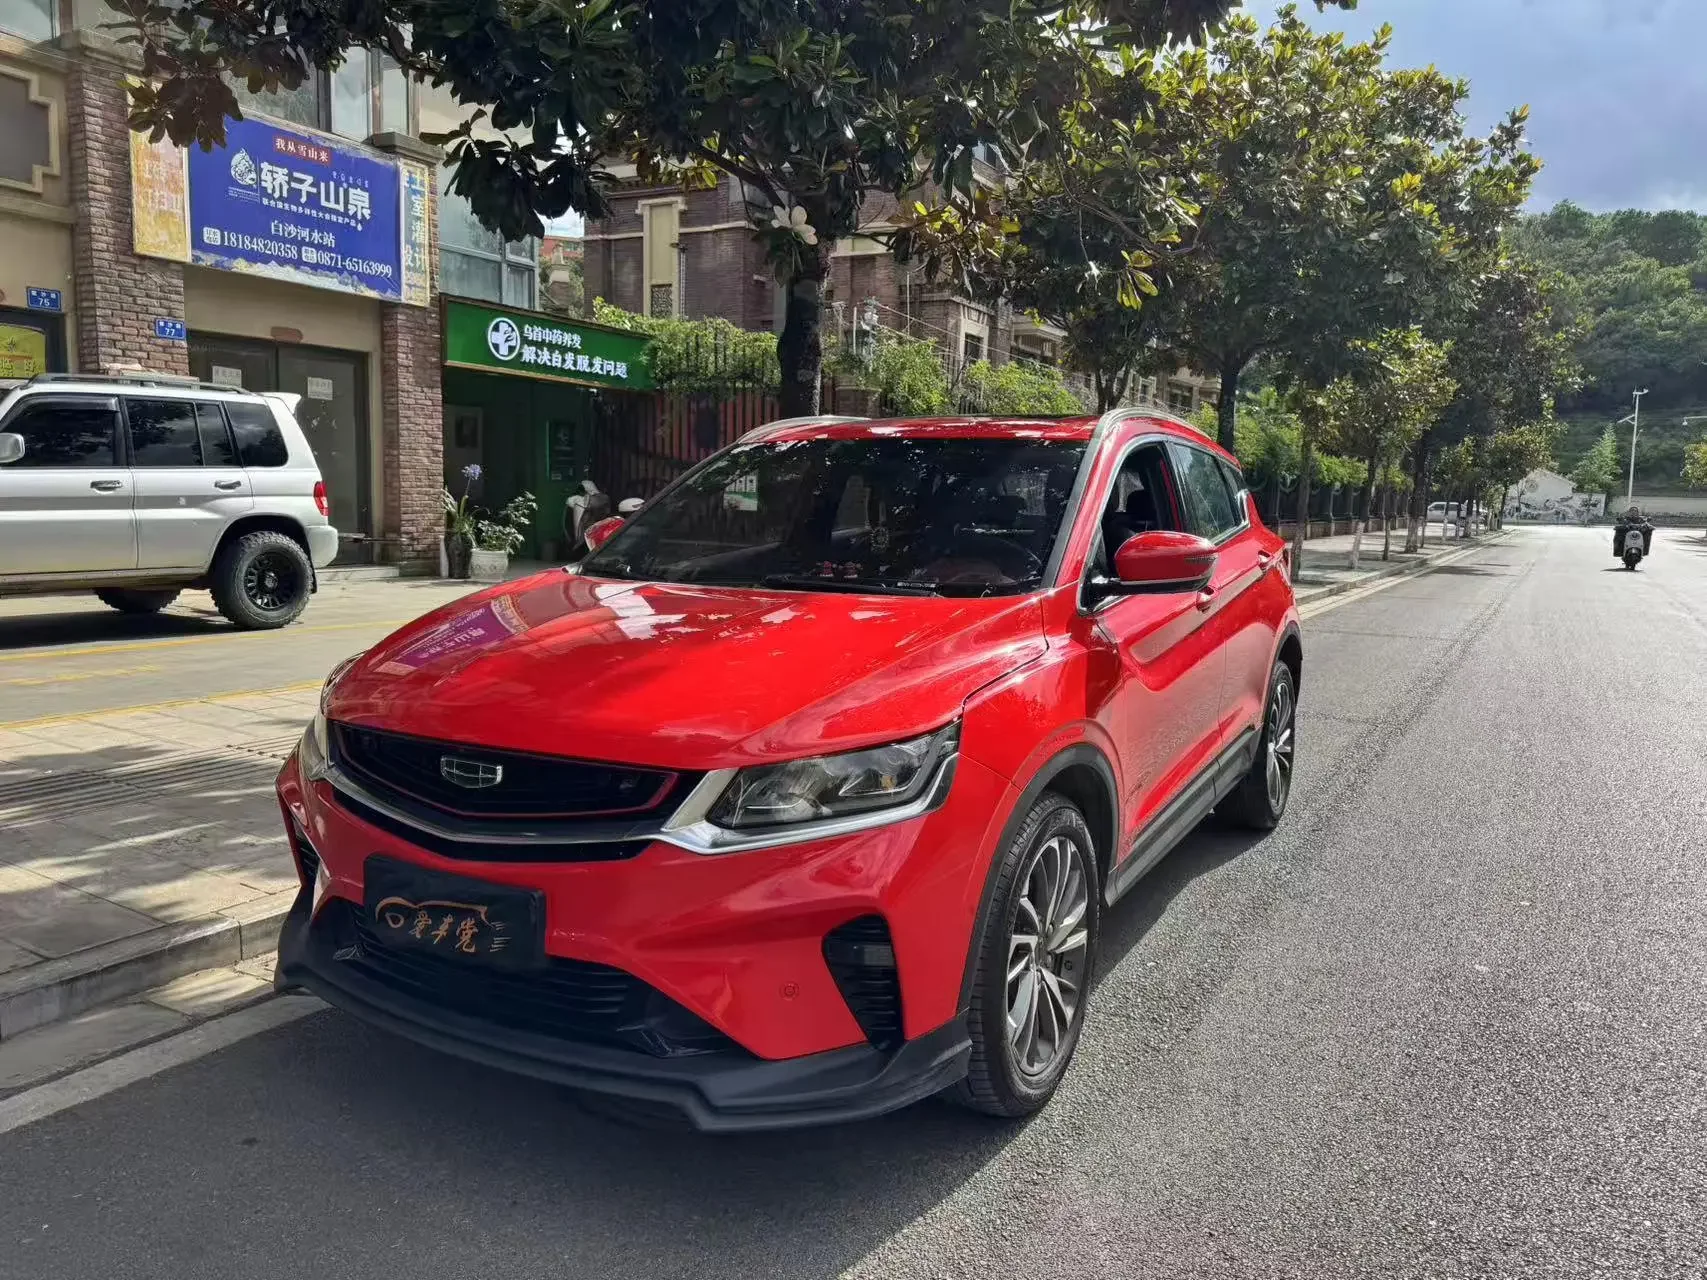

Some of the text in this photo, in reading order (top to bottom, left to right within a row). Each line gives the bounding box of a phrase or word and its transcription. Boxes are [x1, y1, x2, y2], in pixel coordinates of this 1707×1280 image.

[275, 138, 329, 162] 我从雪山来
[260, 161, 371, 221] 轿子山泉
[223, 231, 298, 259] 18184820358
[270, 219, 336, 248] 白沙河水站
[317, 250, 393, 278] 0871-65163999
[38, 297, 50, 306] 75
[164, 327, 176, 336] 77
[523, 325, 582, 349] 乌首中药养发
[521, 344, 628, 377] 解决白发脱发问题
